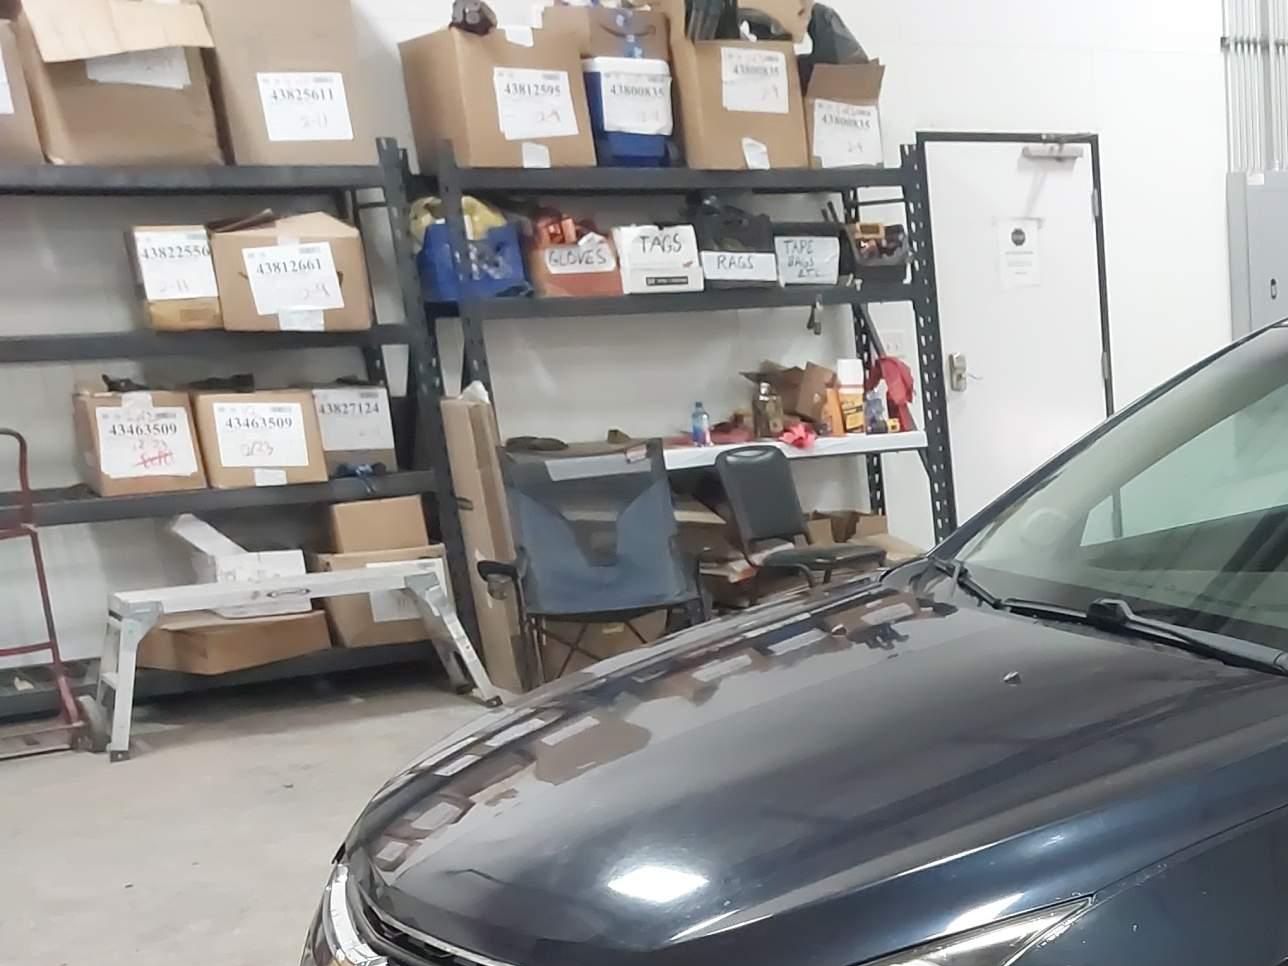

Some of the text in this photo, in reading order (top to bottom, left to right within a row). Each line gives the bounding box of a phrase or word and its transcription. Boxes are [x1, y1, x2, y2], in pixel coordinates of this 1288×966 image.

[272, 88, 333, 101] 43825611
[639, 233, 683, 254] TAGS
[783, 240, 814, 255] TAPE
[141, 245, 210, 260] 43822556
[548, 249, 607, 267] GLOVES
[256, 258, 322, 275] 43812661
[717, 256, 754, 270] RAGS
[319, 402, 379, 415] 43827124
[109, 424, 177, 436] 43463509
[226, 417, 293, 430] 43463509
